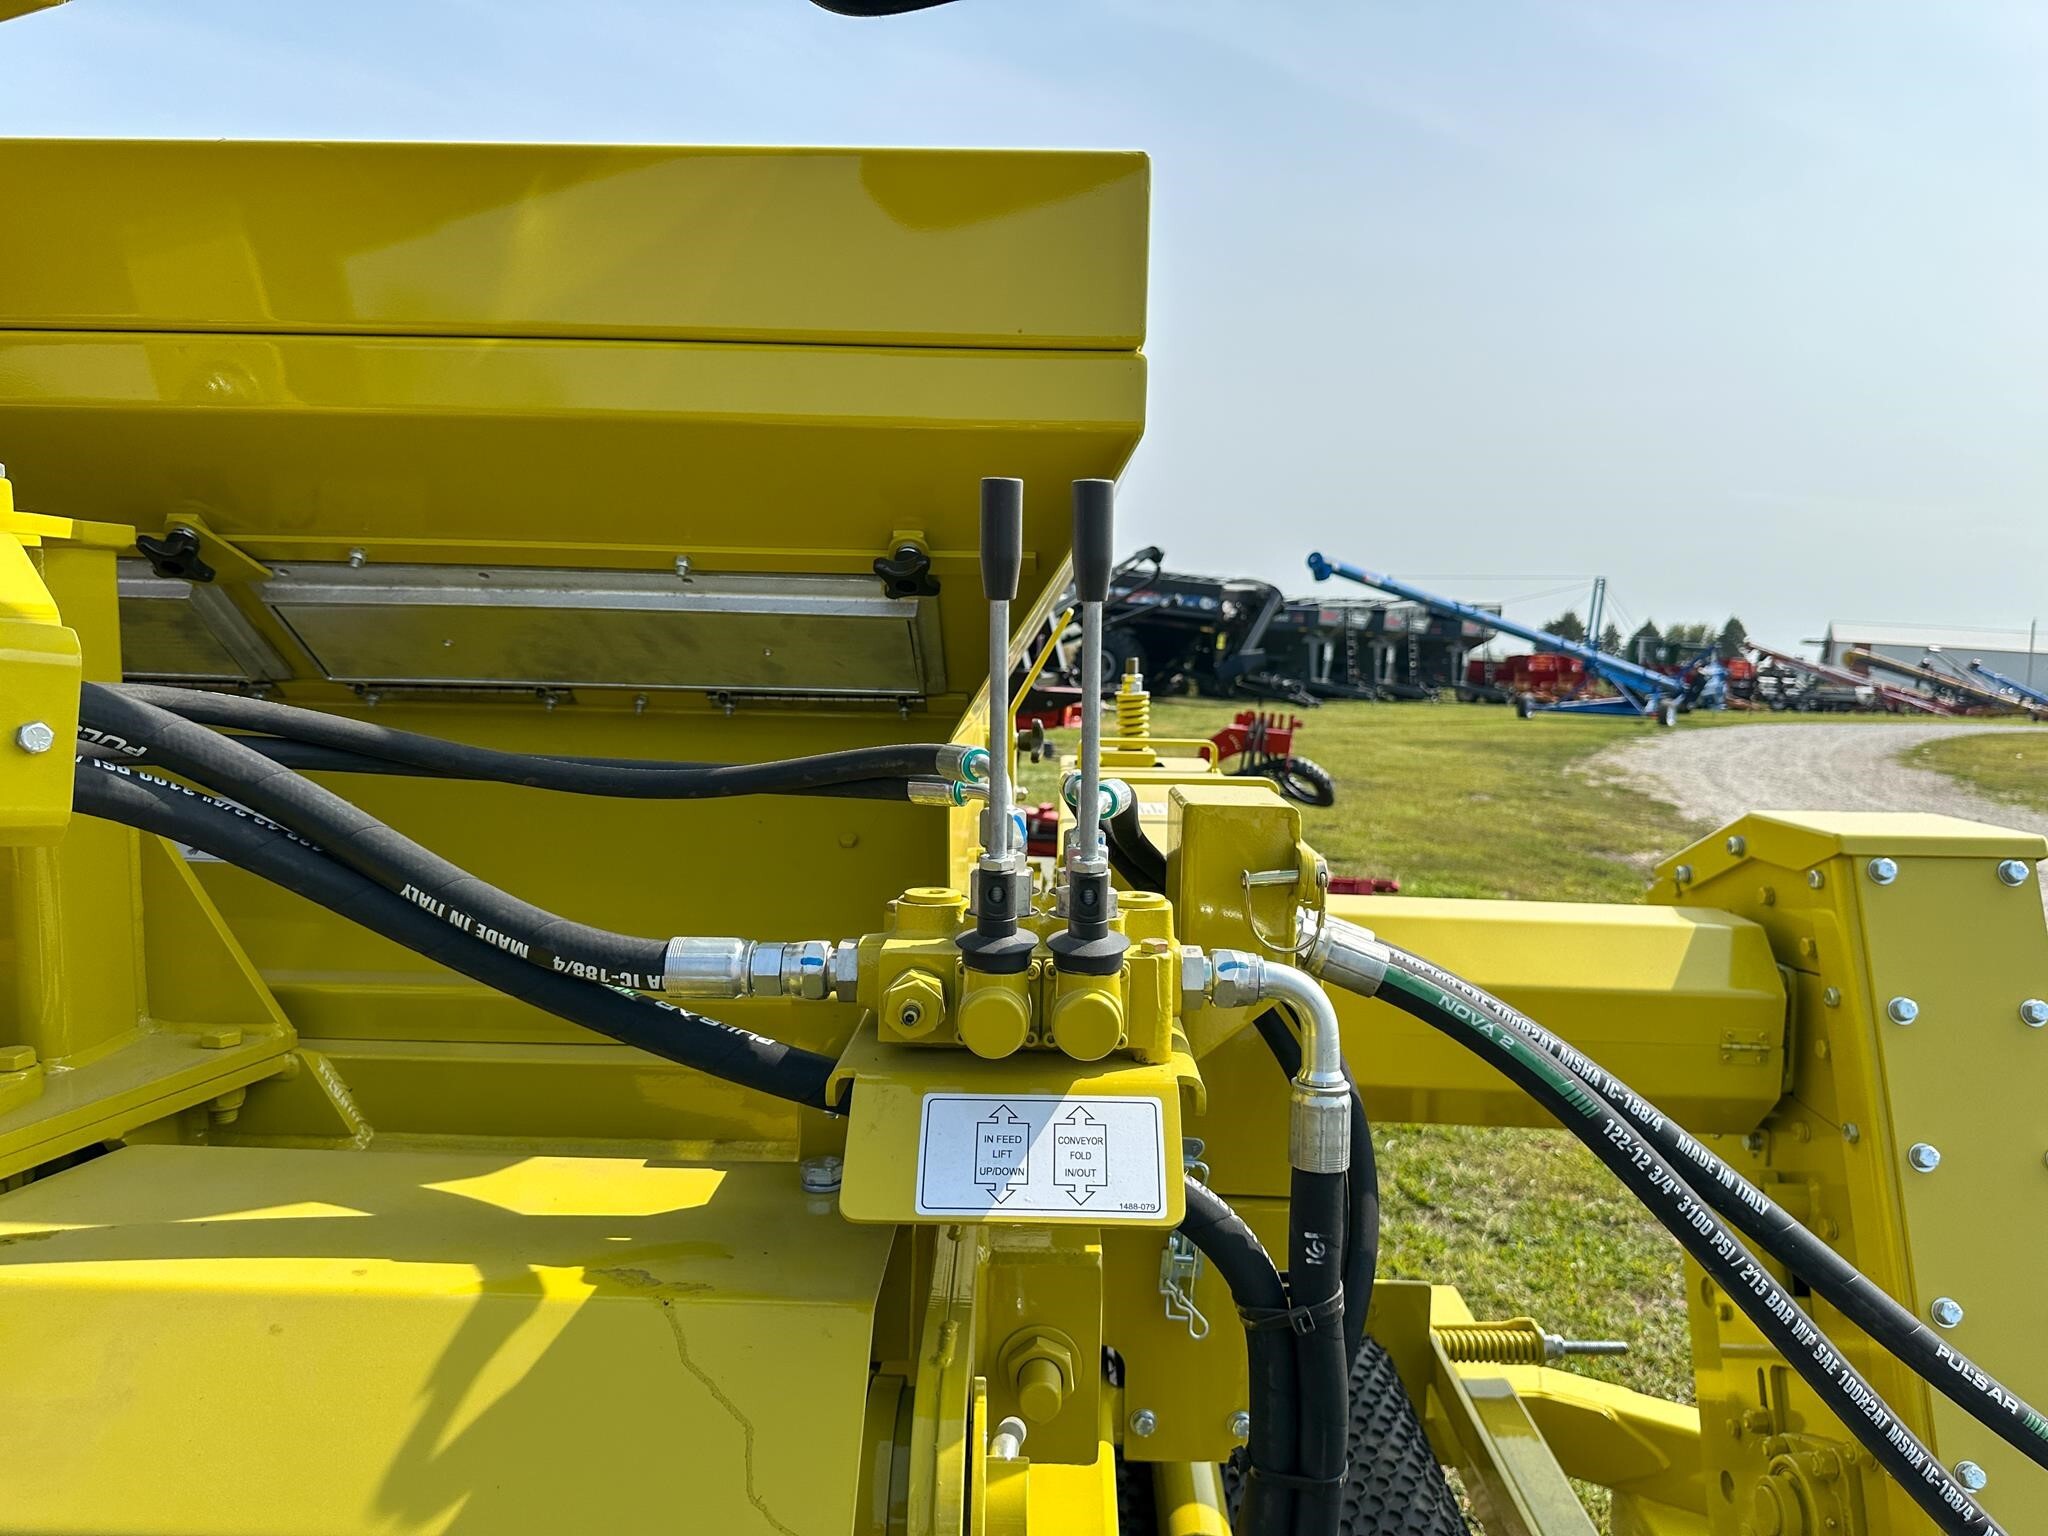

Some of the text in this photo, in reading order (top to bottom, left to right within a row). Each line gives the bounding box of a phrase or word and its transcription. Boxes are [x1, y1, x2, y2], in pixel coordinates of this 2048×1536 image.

[400, 884, 445, 918] ITALY
[449, 905, 472, 931] IN
[476, 923, 530, 959] MADE
[553, 955, 640, 987] IC-188/4
[1438, 996, 1515, 1050] NOVA 2
[984, 1135, 1022, 1144] IN FEED
[1057, 1136, 1104, 1146] CONVEYOR
[1558, 1047, 1601, 1087] MSHA
[1602, 1078, 1665, 1133] IC-188/4
[1675, 1134, 1716, 1175] MADE
[1715, 1163, 1736, 1189] IN
[1734, 1178, 1771, 1216] ITALY
[992, 1150, 1013, 1159] LIFT
[1070, 1151, 1092, 1160] FOLD
[979, 1167, 1025, 1176] UP/DOWN
[1064, 1168, 1097, 1178] IN/OUT
[1119, 1203, 1156, 1211] 1488-079
[1603, 1118, 1652, 1171] 122-12
[1648, 1159, 1681, 1197] 3/4"
[1677, 1194, 1713, 1237] 3100
[1709, 1229, 1736, 1261] PSI
[1740, 1263, 1767, 1296] 215
[1765, 1287, 1795, 1325] BAR
[1791, 1318, 1818, 1346] WP
[1812, 1342, 1842, 1376] SAE
[1837, 1369, 1890, 1430] 100R2AT
[1885, 1422, 1928, 1470] MSHA
[1921, 1462, 1974, 1523] IC-188/4
[1935, 1343, 2021, 1415] PULSAR
